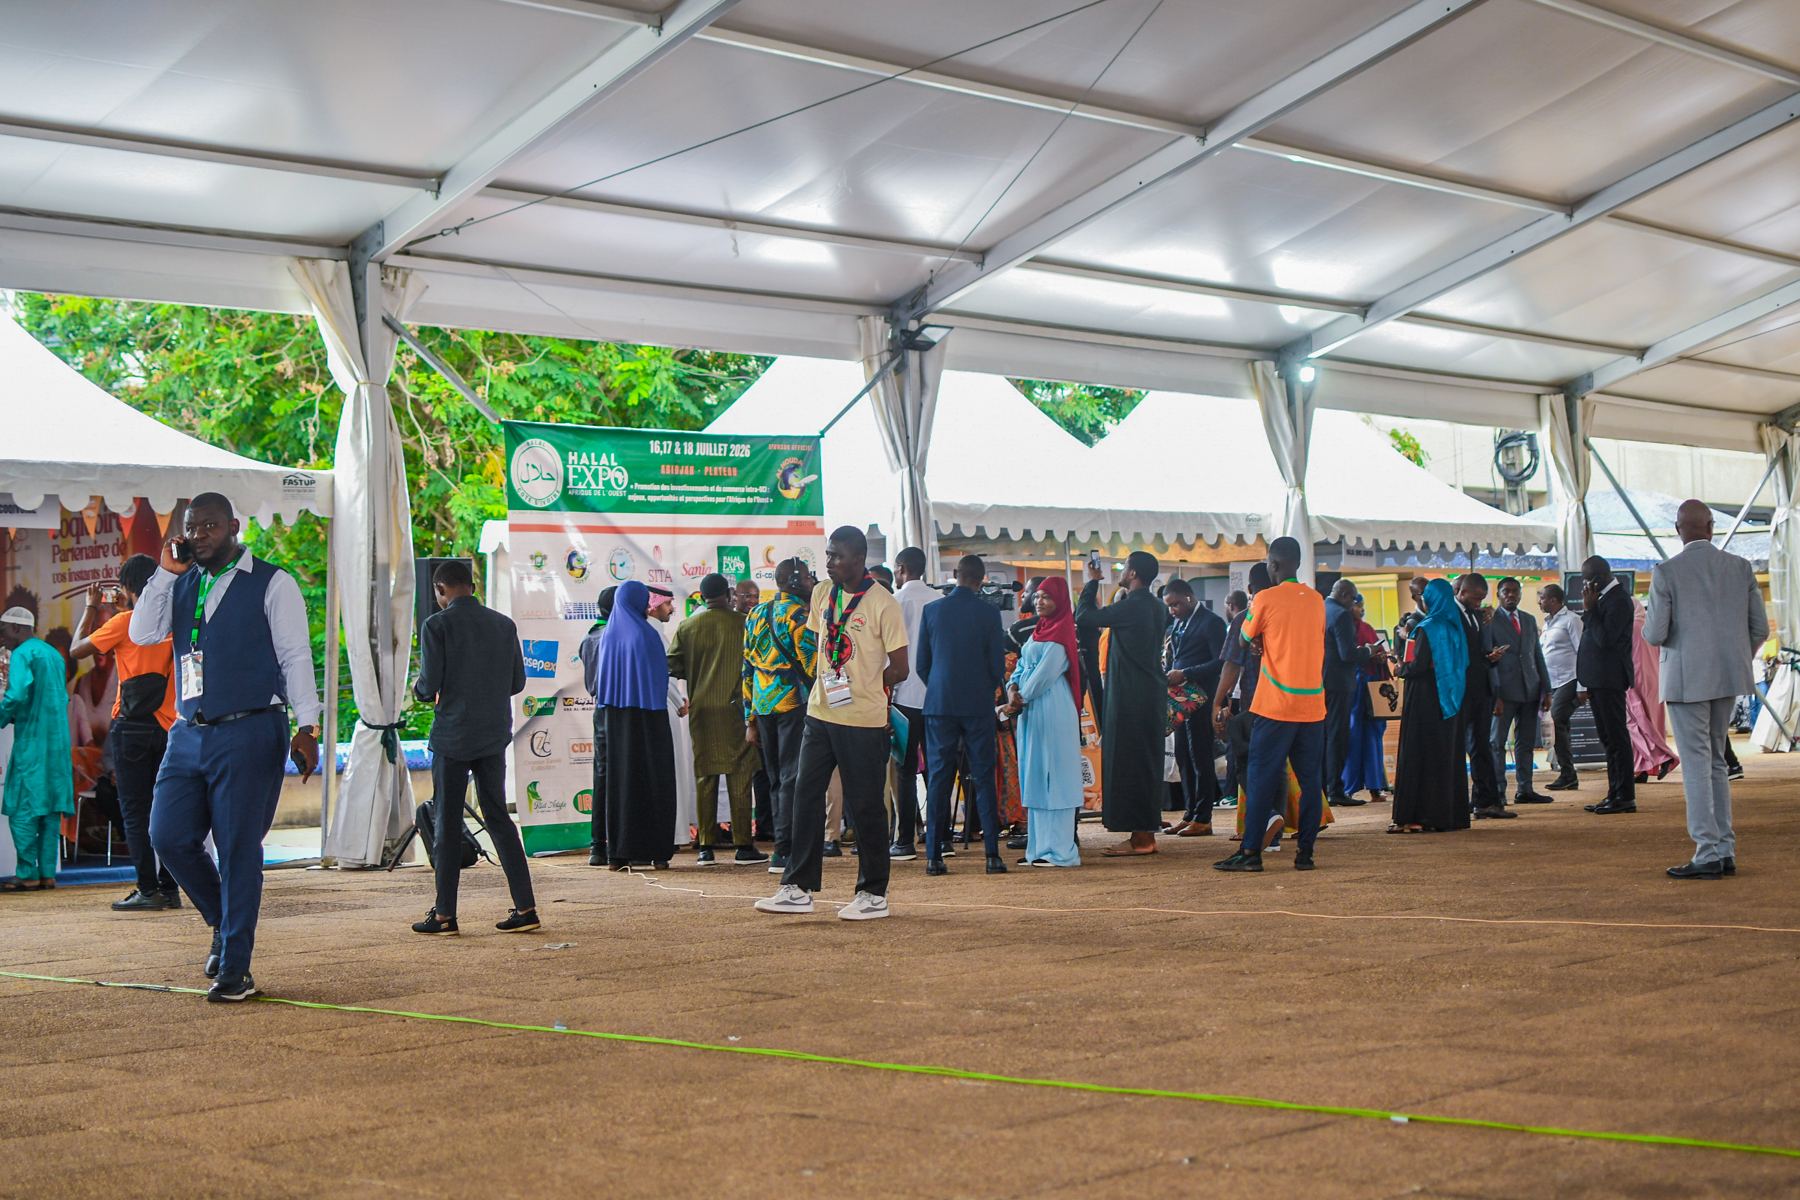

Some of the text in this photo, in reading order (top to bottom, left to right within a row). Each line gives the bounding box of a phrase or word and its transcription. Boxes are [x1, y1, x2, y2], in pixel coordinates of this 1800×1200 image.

[649, 440, 751, 458] 16,17 & 18 JUILLET 2026
[568, 451, 618, 466] HALAL
[520, 463, 556, 484] حلال
[566, 464, 629, 490] EXPO
[704, 466, 738, 477] PLATEAU
[52, 538, 128, 563] Partenaire de
[52, 572, 67, 584] vos
[67, 568, 101, 583] instants
[102, 564, 113, 578] de
[648, 568, 672, 583] SITA
[681, 561, 712, 577] Sania
